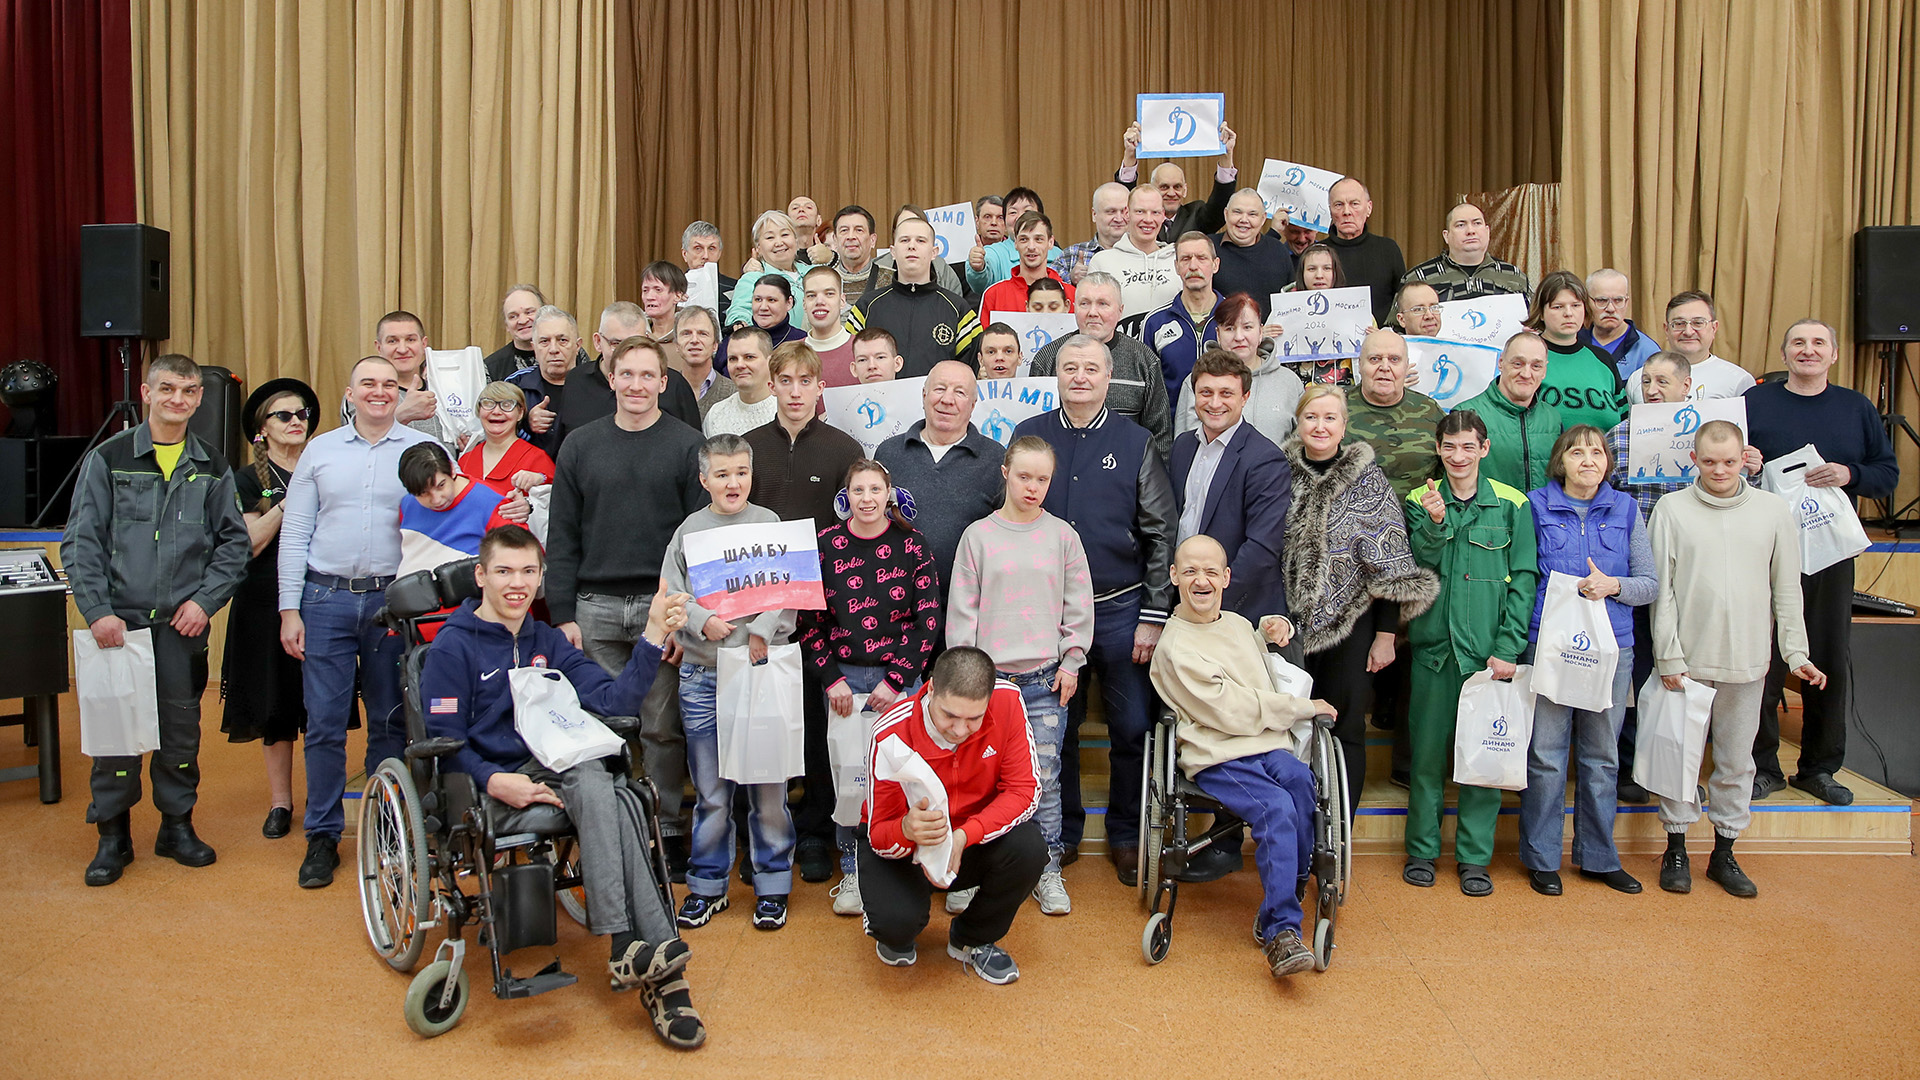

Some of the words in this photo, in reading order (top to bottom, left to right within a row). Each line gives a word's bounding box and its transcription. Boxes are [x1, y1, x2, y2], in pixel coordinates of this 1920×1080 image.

[925, 211, 965, 227] АМО
[1304, 321, 1327, 330] 2026
[976, 380, 1055, 412] НАМО
[1800, 512, 1835, 529] ДИНАМО
[723, 543, 788, 564] ШАЙБУ
[833, 556, 866, 574] Barbie
[726, 570, 791, 594] ШАЙБУ
[876, 566, 907, 583] Barbie
[847, 596, 878, 613] Barbie
[864, 636, 894, 653] Barbie
[1560, 651, 1599, 664] ДИНАМО
[1564, 659, 1592, 668] МОСКВА
